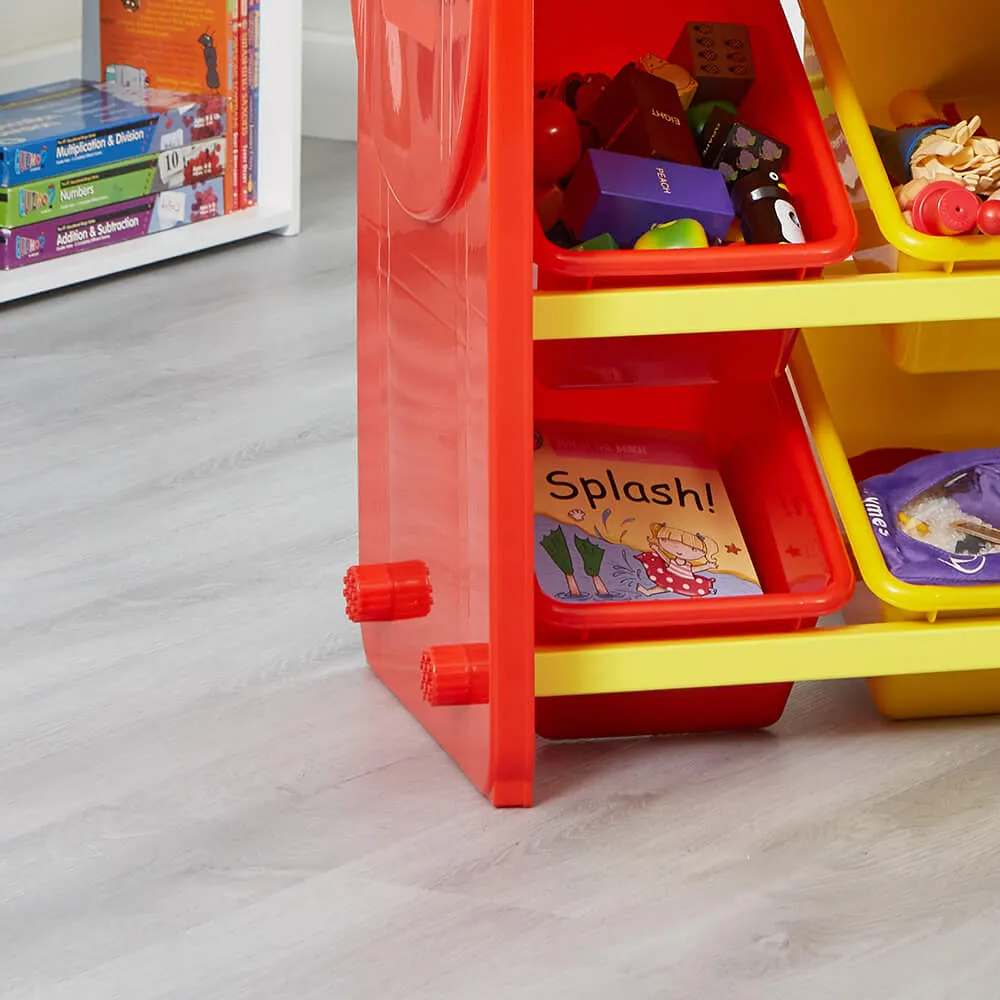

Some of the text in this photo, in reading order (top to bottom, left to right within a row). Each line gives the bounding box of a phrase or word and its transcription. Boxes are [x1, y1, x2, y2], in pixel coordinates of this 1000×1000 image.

[56, 138, 106, 158] Multiplication
[107, 135, 114, 147] &
[116, 129, 144, 145] Division
[166, 151, 179, 170] 10
[60, 185, 94, 202] Numbers
[656, 167, 672, 195] PEACH
[56, 230, 88, 246] Addition
[89, 226, 96, 237] &
[97, 216, 139, 235] Subtraction
[546, 469, 715, 513] Splash!
